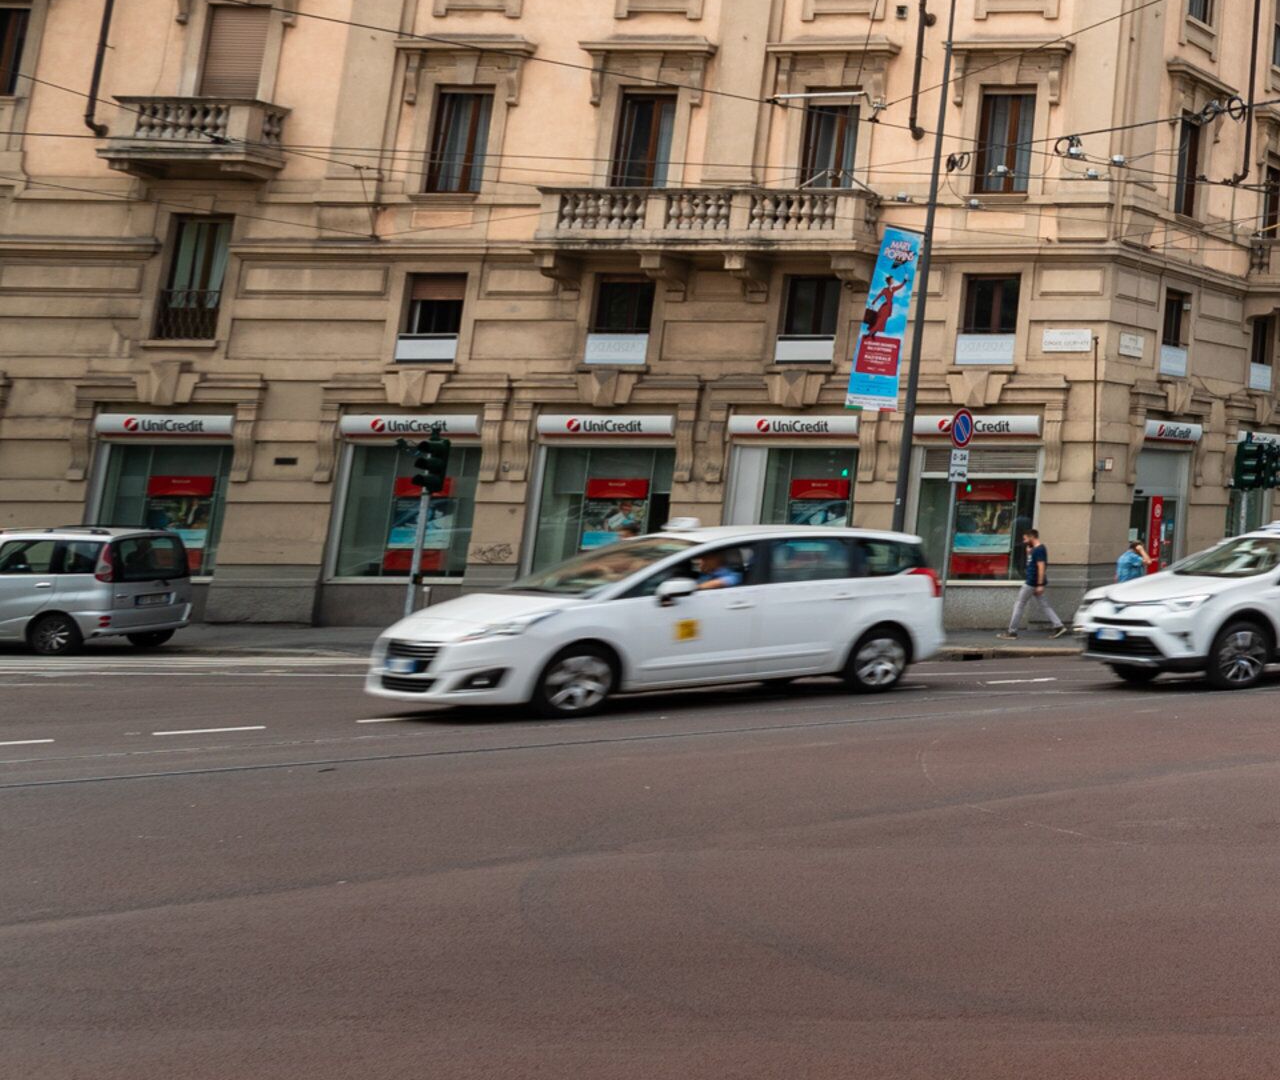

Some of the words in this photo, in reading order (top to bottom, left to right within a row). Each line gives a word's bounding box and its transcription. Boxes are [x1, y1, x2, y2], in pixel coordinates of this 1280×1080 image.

[141, 419, 204, 433] UniCredit
[388, 419, 447, 433] UniCredit
[583, 419, 643, 433] UniCredit
[772, 419, 829, 433] UniCredit
[973, 420, 1011, 433] Credit
